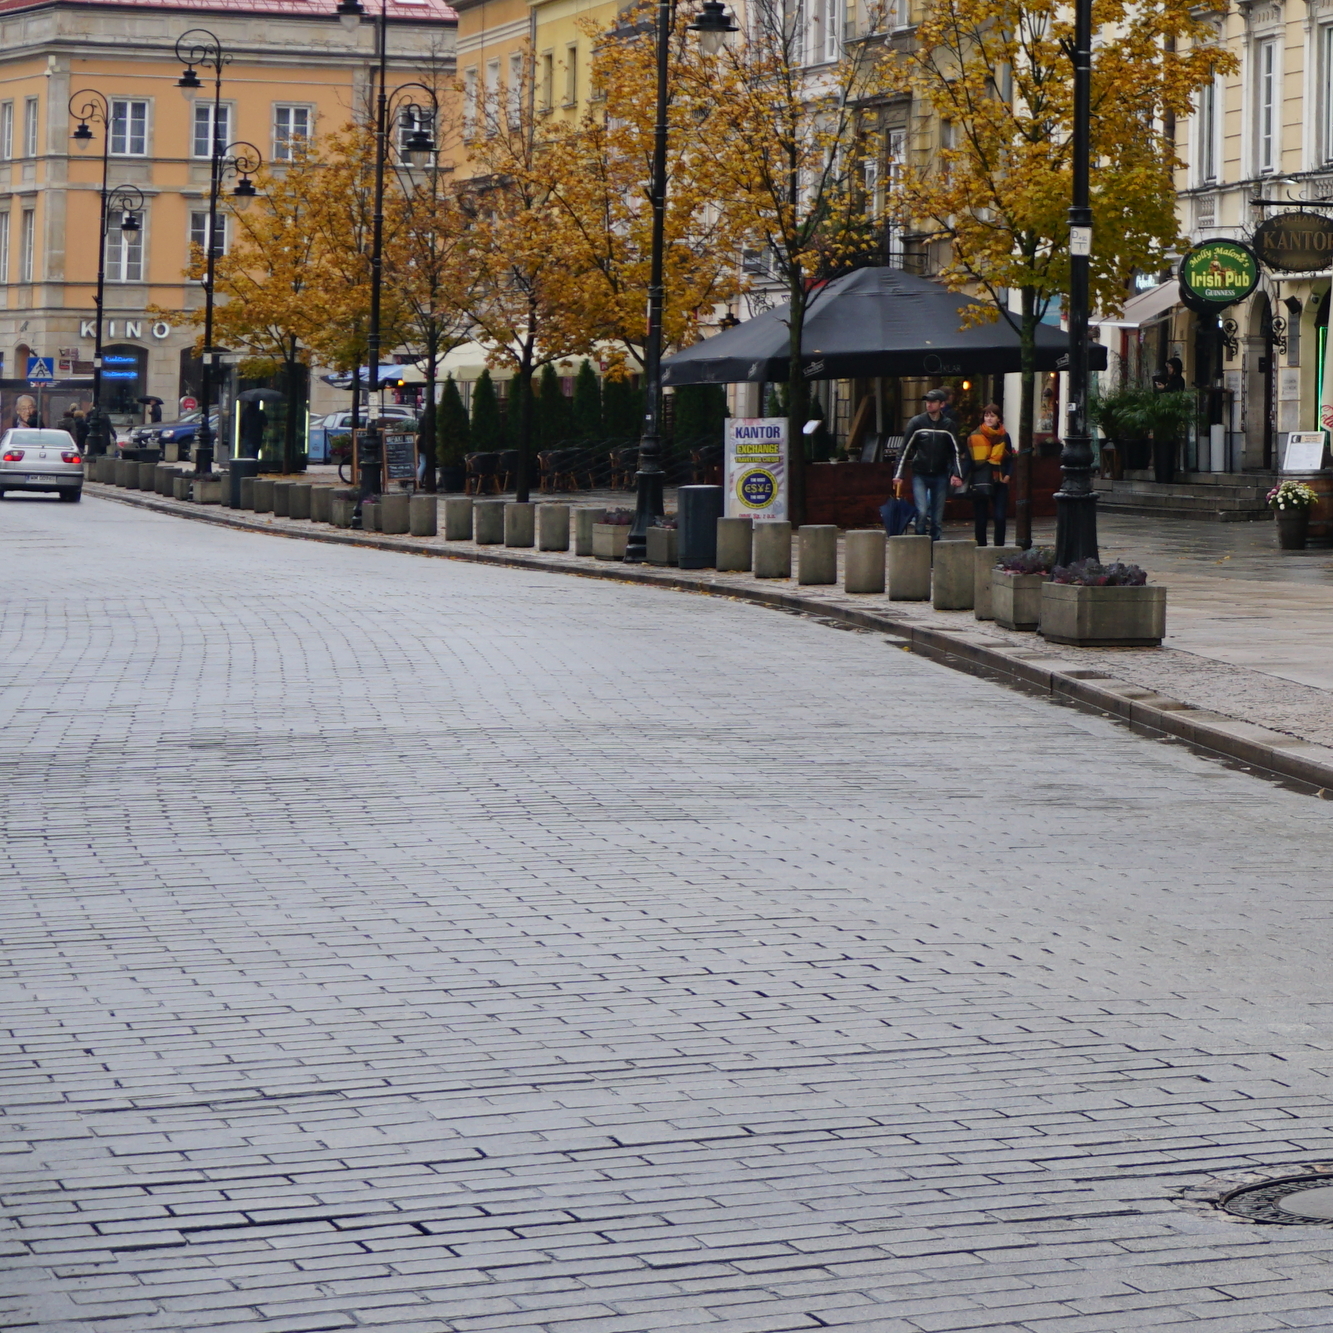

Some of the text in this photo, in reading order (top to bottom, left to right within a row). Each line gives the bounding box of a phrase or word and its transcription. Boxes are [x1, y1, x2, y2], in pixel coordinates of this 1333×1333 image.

[1273, 215, 1330, 227] EXCHANGE
[1189, 248, 1212, 268] Molly
[1213, 247, 1249, 268] Malone's
[1191, 271, 1249, 287] Irish Pub
[1205, 288, 1236, 296] GUINNESS
[80, 321, 170, 339] KINO
[735, 426, 780, 439] KANTOR
[736, 444, 779, 454] EXCHANGE
